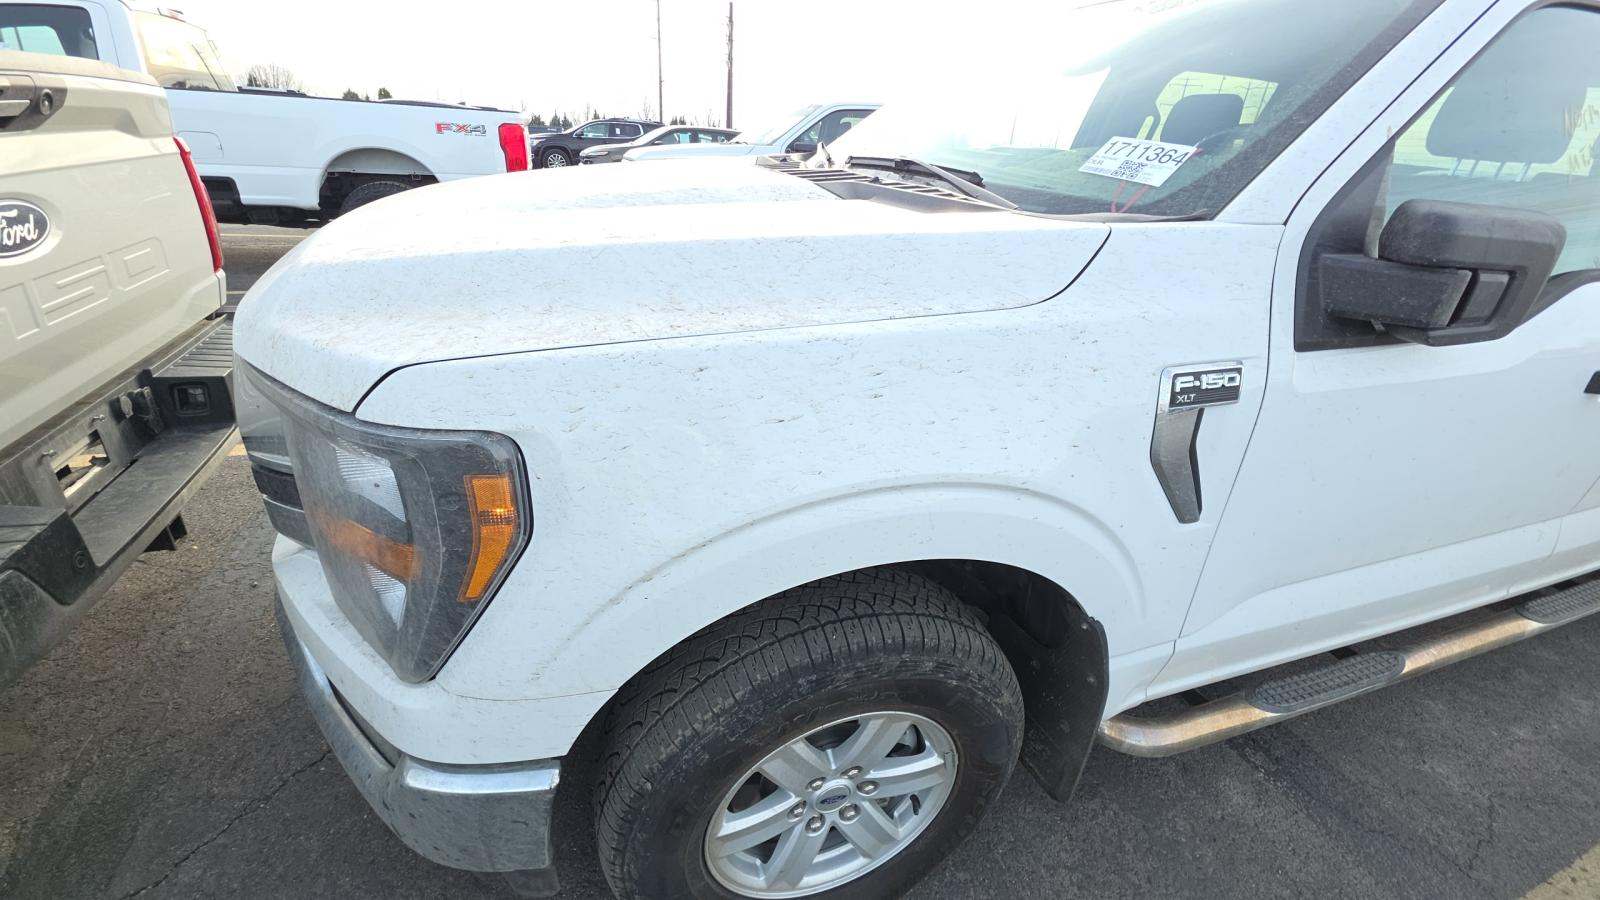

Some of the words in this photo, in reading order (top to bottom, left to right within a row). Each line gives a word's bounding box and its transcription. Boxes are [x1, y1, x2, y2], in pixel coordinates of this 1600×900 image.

[436, 123, 487, 135] FX4
[1104, 140, 1190, 167] 1711364
[1174, 371, 1241, 393] F-150
[1176, 393, 1196, 403] XLT
